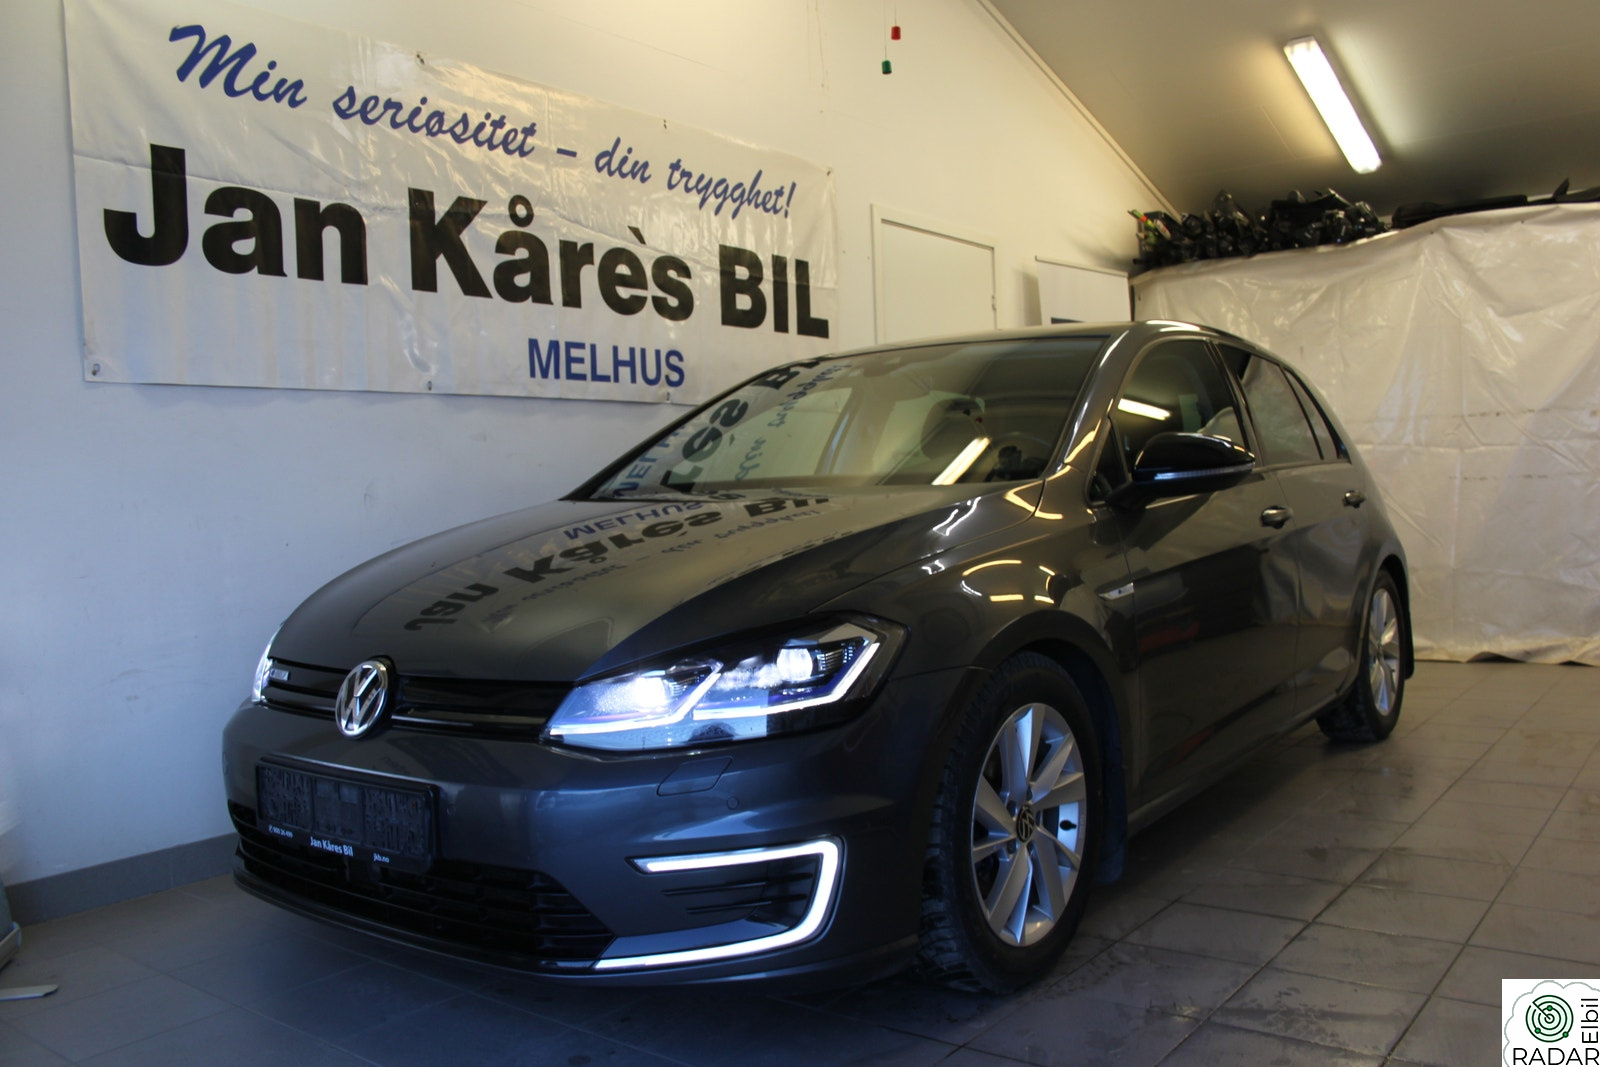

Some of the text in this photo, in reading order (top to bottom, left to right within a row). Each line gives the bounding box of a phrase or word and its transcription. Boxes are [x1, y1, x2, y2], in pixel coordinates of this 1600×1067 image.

[169, 25, 307, 108] Min
[332, 85, 536, 158] seriøsitet
[595, 137, 651, 184] din
[667, 170, 796, 219] trygghet!
[103, 143, 829, 339] Jan Kårès BIL
[528, 338, 686, 388] MELHUS
[310, 835, 322, 849] Jan
[343, 845, 354, 857] Bil
